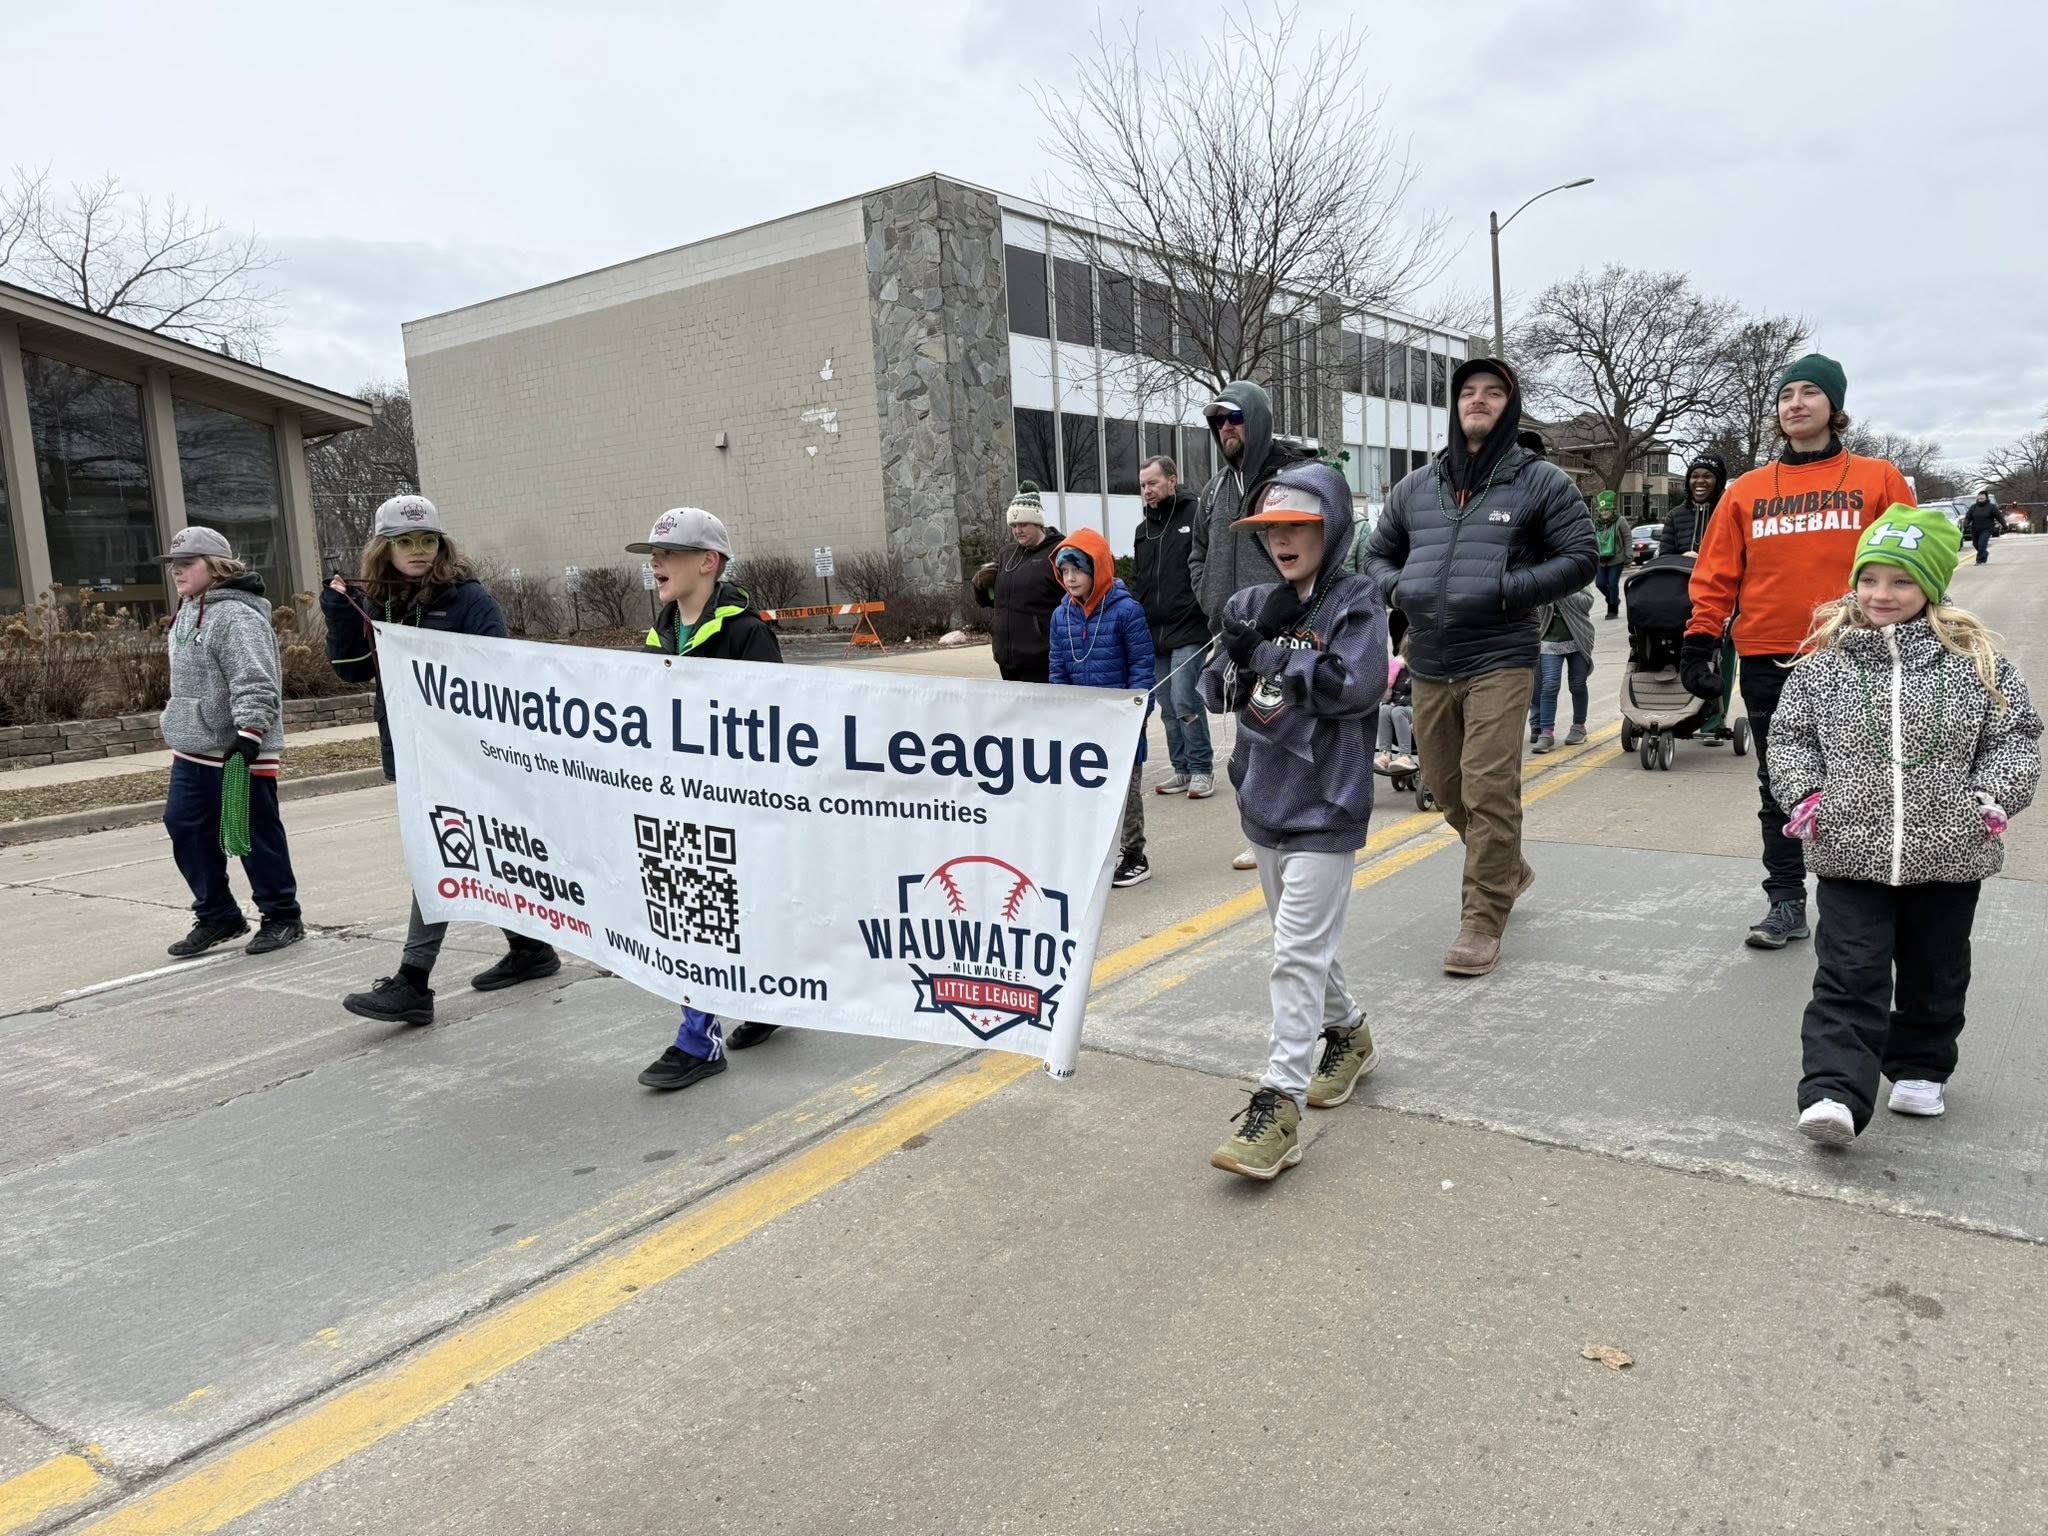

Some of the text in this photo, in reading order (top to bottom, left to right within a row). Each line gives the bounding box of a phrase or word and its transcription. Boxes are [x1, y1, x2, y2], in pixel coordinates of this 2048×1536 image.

[1752, 489, 1864, 520] BOMBERS
[1752, 510, 1862, 539] BASEBALL
[775, 606, 833, 619] STREET CLOSED
[411, 659, 1109, 795] Wauwatosa Little League
[479, 739, 988, 825] Serving the Milwaukee & Wauwatosa communities
[477, 814, 549, 862] Little
[485, 847, 586, 907] League
[437, 876, 593, 939] Official Program
[605, 927, 828, 1001] www.tosamll.com
[936, 980, 1036, 1010] LITTLE LEAGUE
